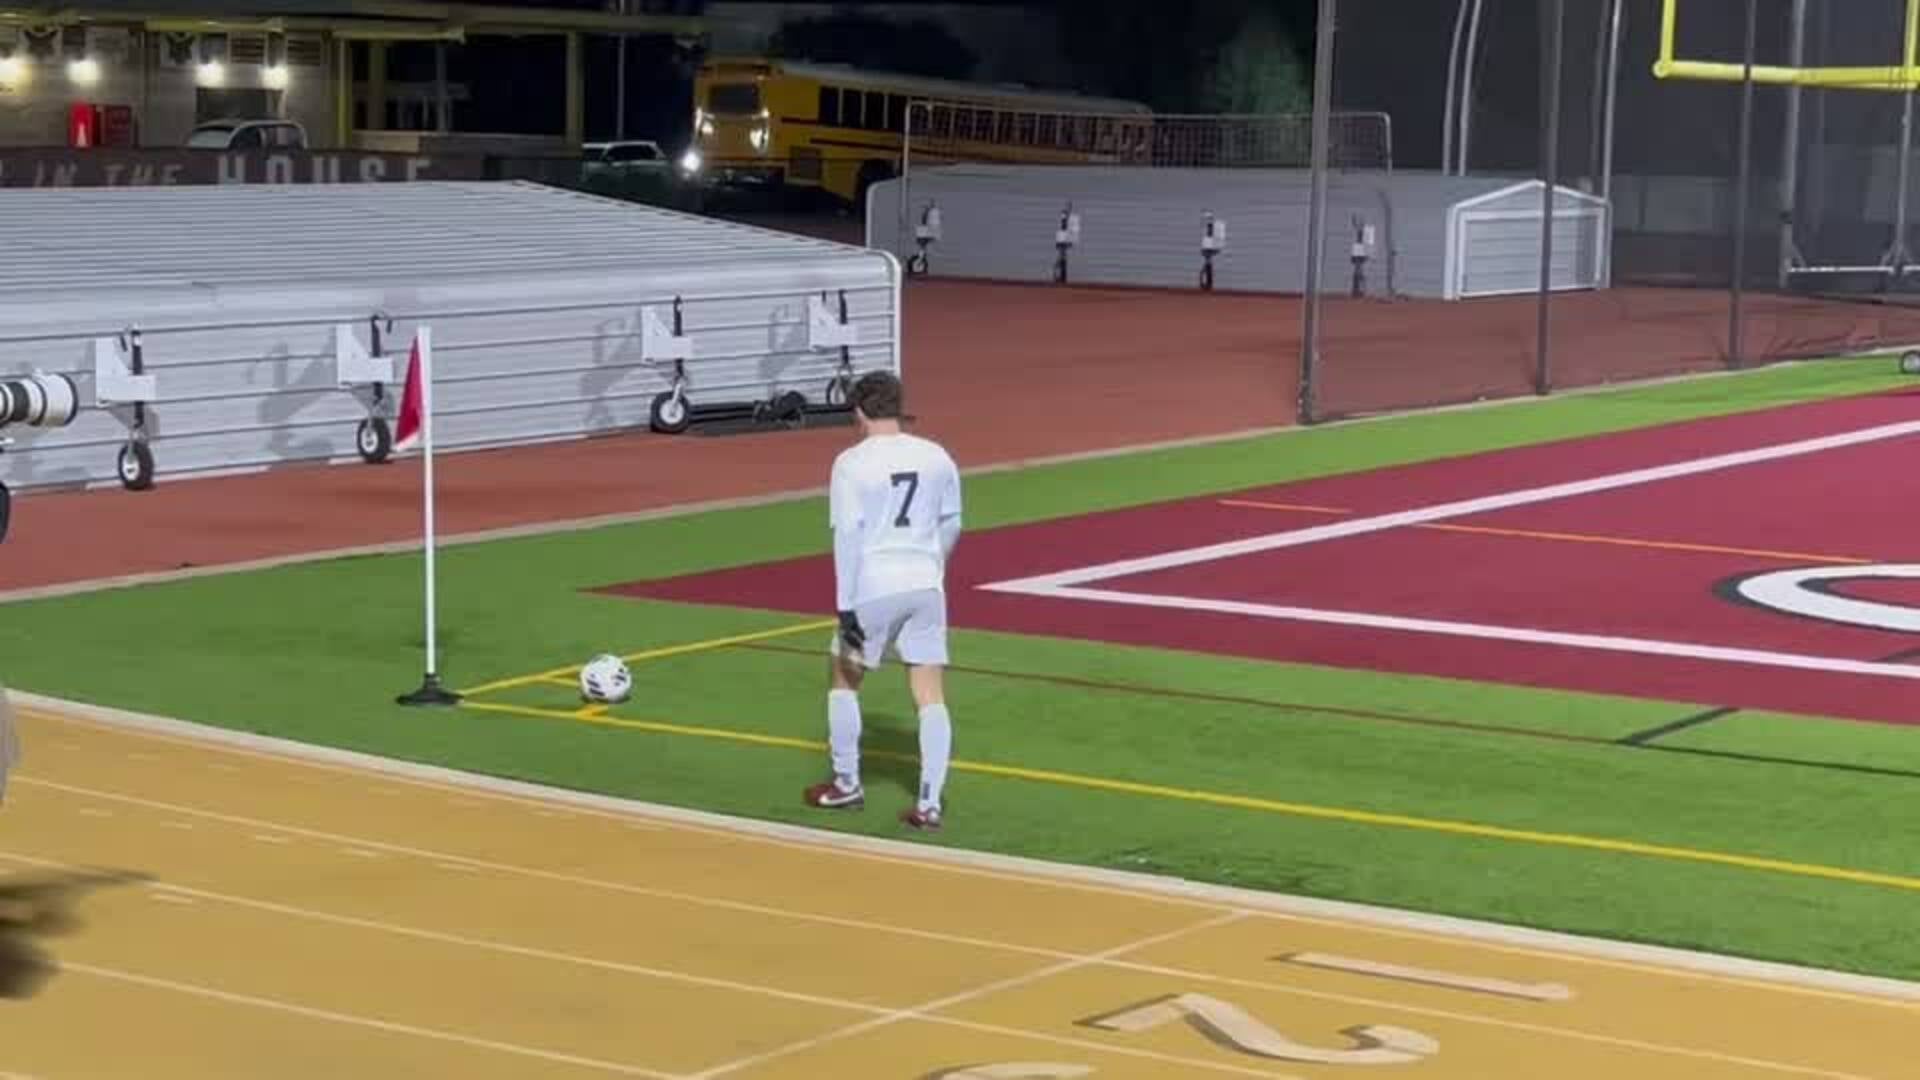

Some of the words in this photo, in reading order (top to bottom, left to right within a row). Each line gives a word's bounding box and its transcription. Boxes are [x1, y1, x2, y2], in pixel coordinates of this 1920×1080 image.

[103, 163, 184, 187] THE
[890, 472, 919, 528] 7
[1072, 992, 1441, 1065] 2
